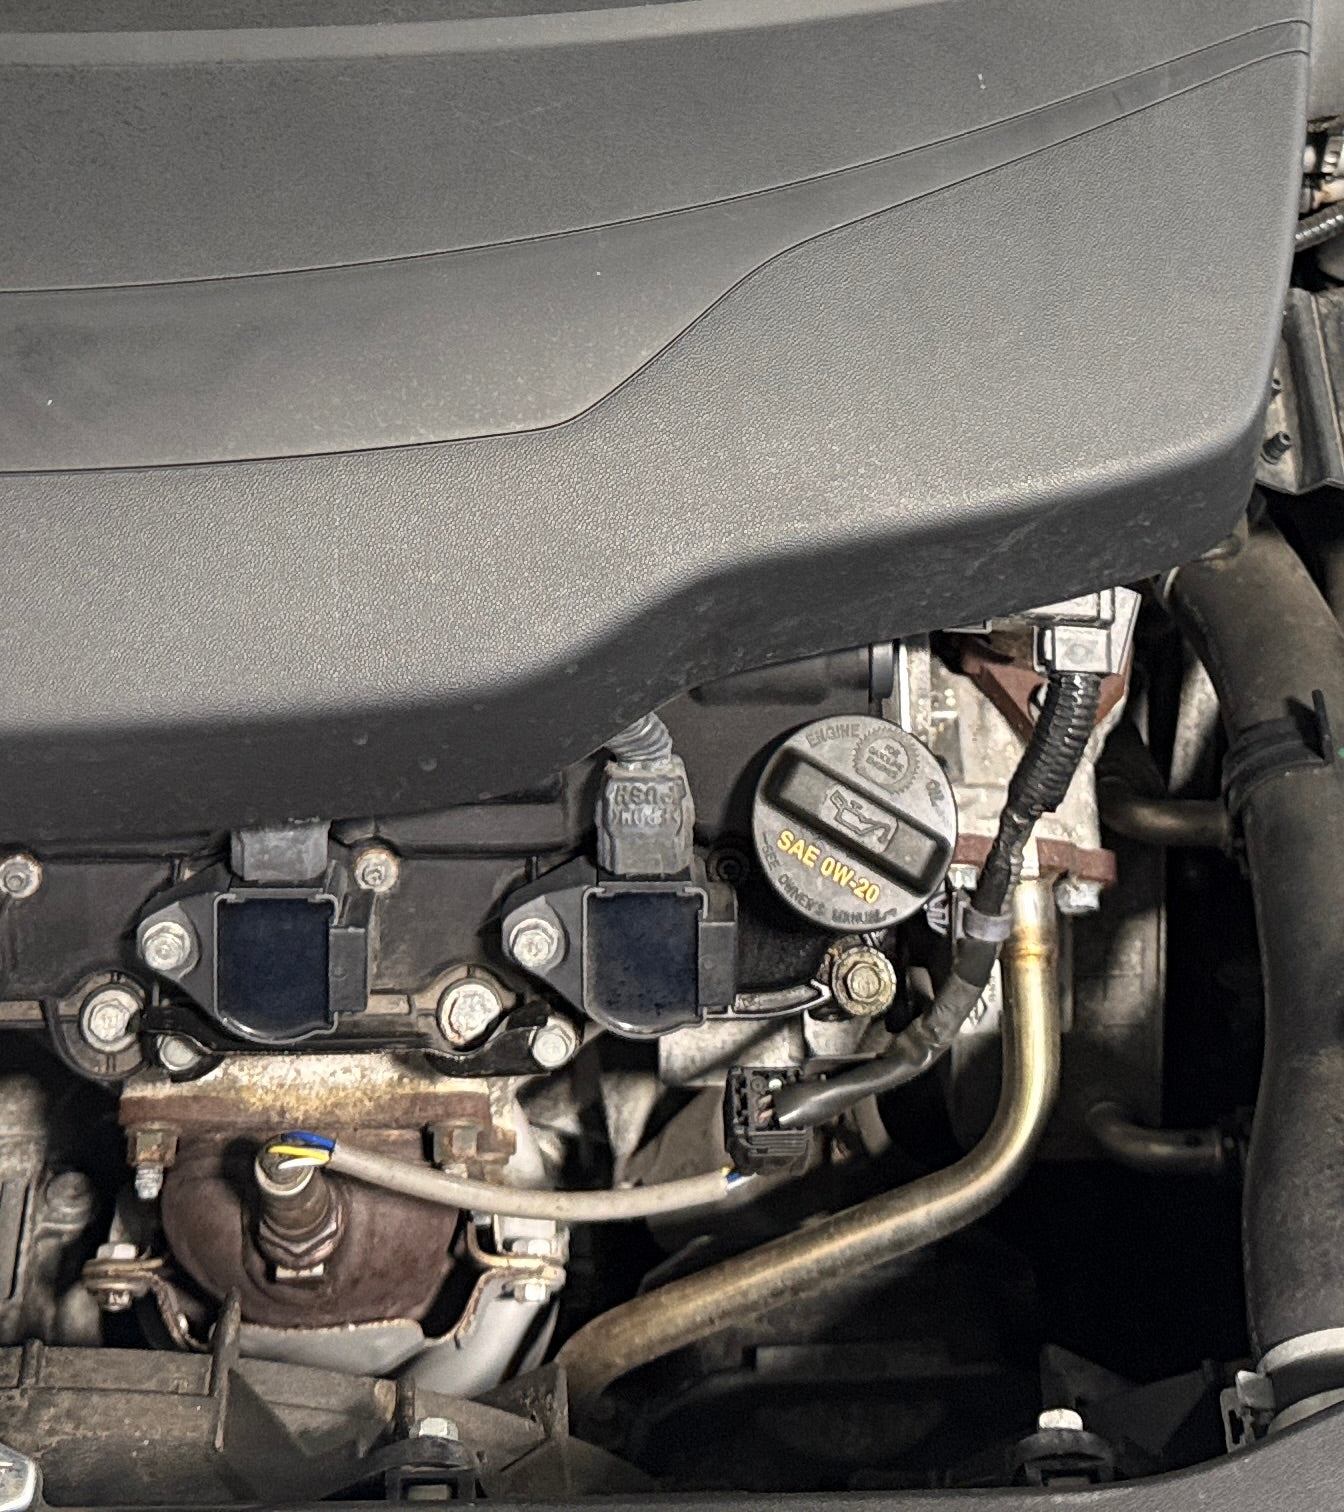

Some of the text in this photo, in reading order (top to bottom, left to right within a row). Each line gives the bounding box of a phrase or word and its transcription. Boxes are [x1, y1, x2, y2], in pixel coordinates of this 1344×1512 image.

[805, 723, 861, 748] ENGINE
[776, 829, 881, 905] SAE 0W-20
